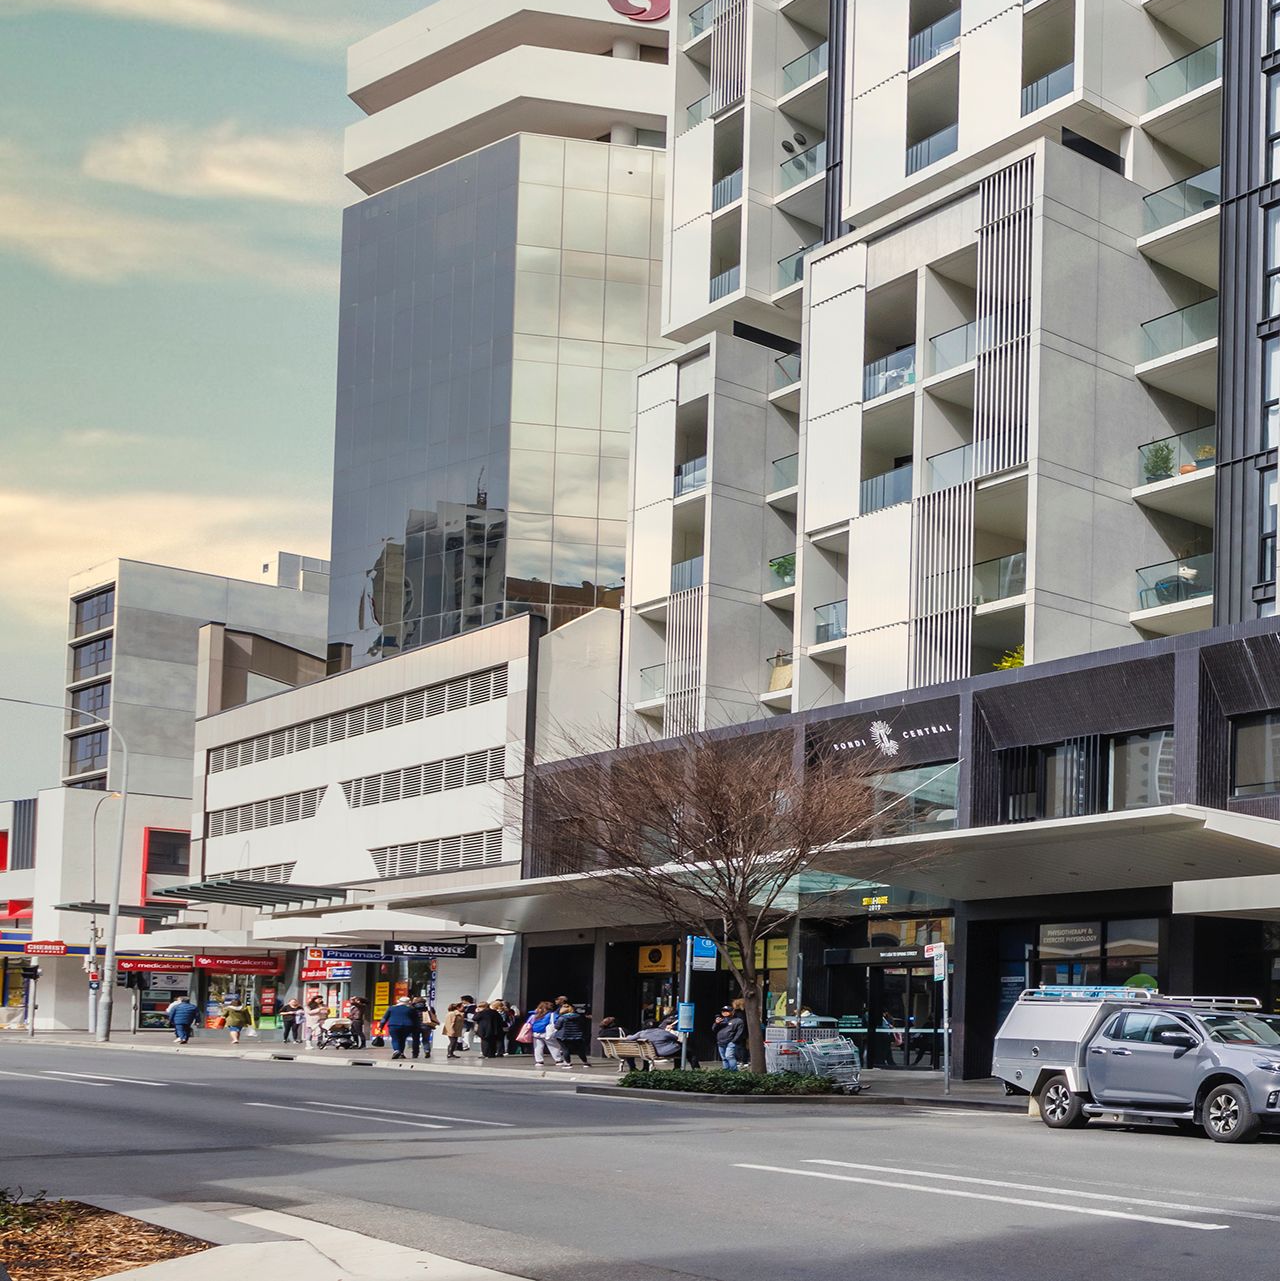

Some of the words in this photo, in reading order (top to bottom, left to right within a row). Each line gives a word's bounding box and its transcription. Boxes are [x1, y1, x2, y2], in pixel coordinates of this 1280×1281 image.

[833, 739, 866, 751] BONDI
[902, 724, 952, 738] CENTRAL
[1047, 928, 1087, 937] PHYSIOTHERAPY
[394, 944, 418, 952] BIG
[419, 945, 466, 954] SMOKE
[327, 951, 386, 961] Pharmacy
